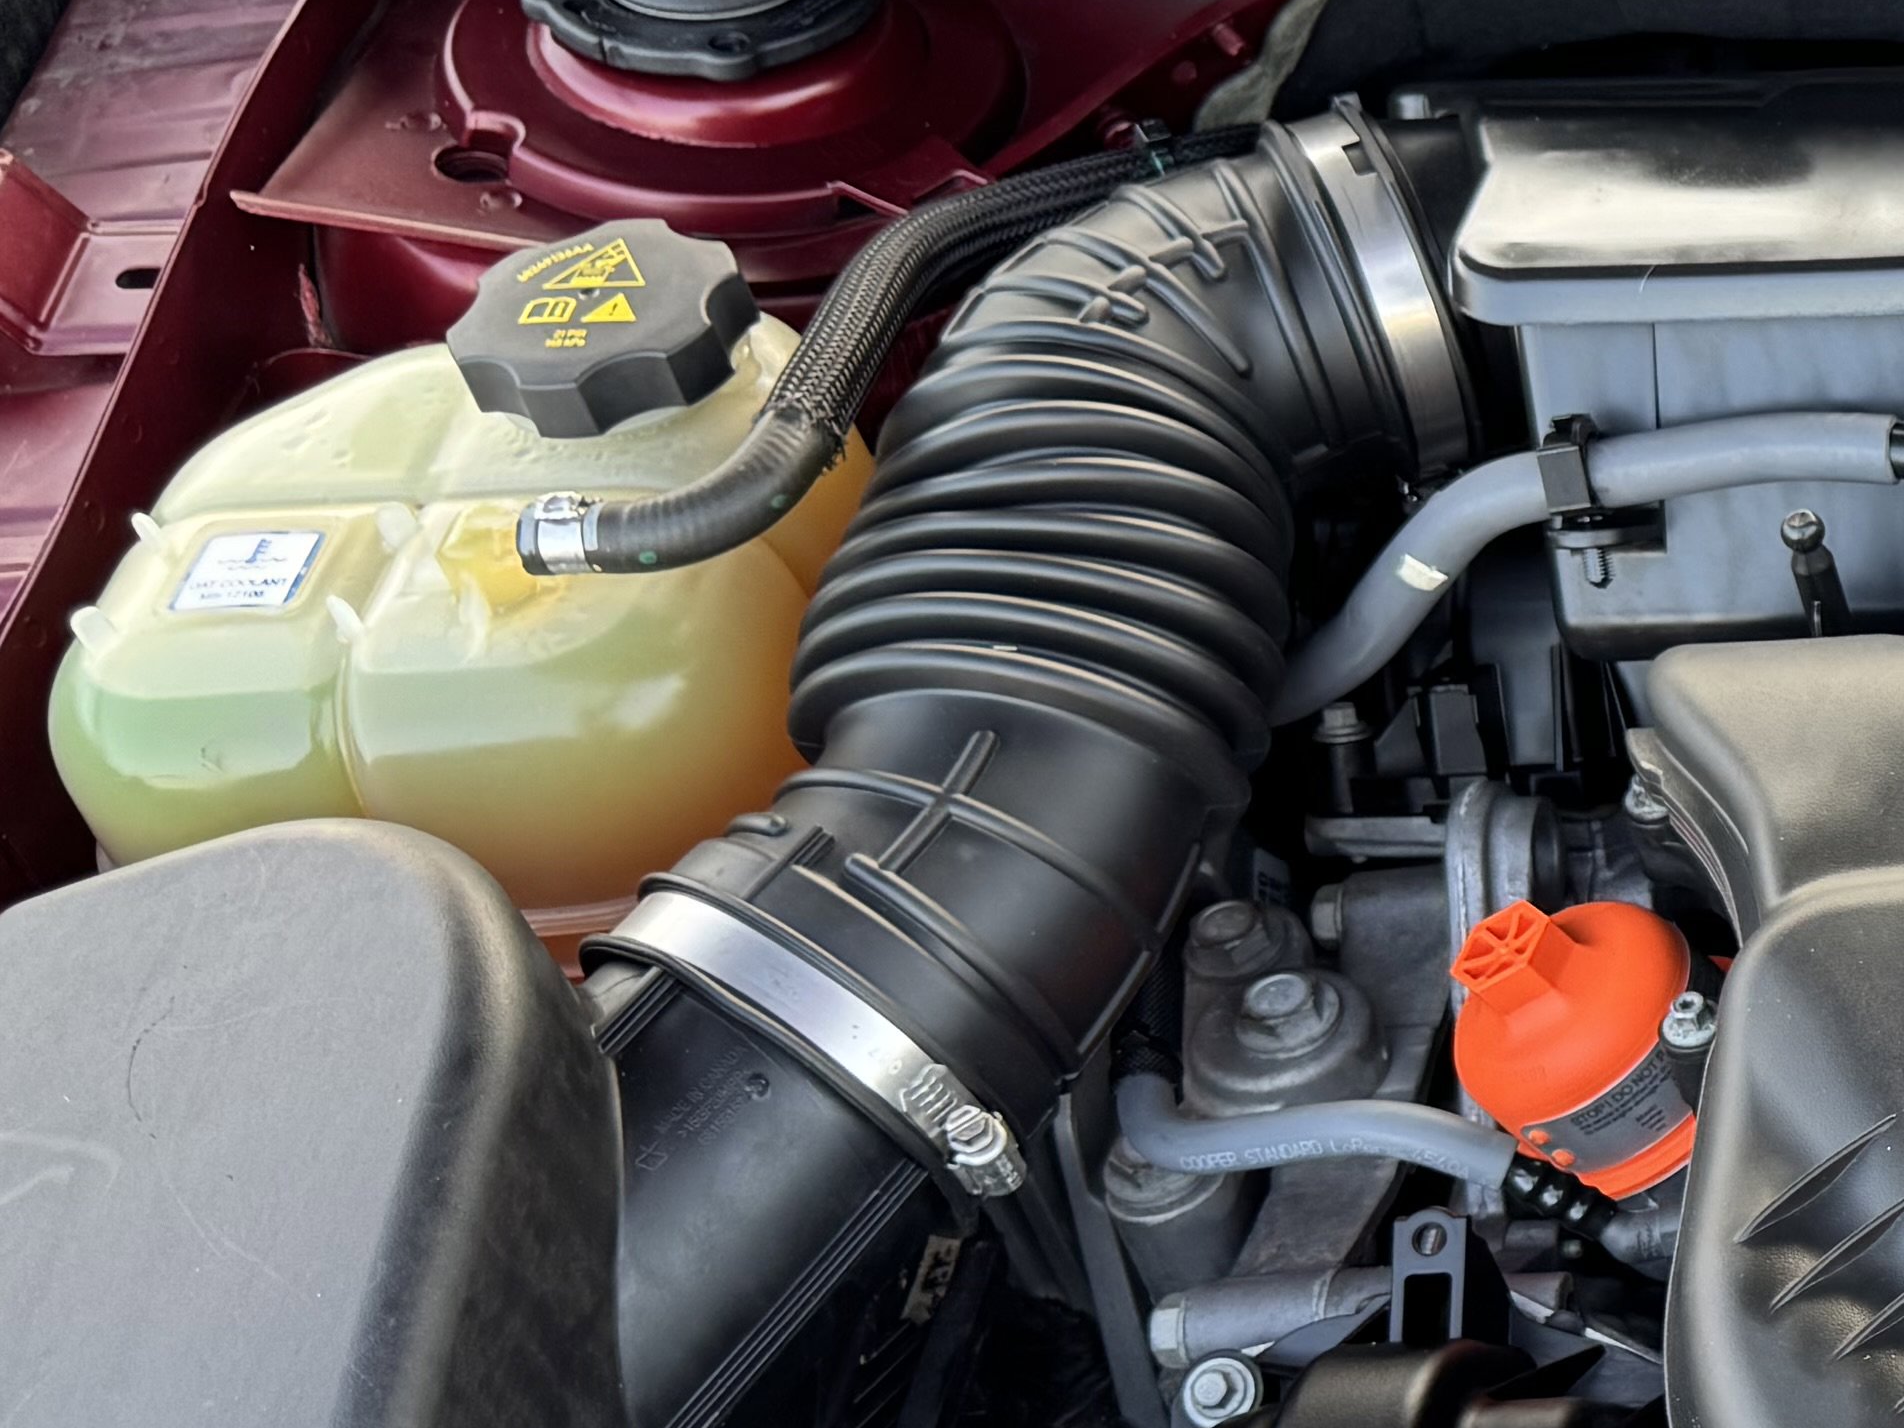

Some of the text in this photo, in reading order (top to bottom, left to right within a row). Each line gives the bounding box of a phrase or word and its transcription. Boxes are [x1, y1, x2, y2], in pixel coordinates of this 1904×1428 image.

[1612, 1085, 1631, 1101] DO
[1632, 1062, 1657, 1086] NOT
[1179, 1150, 1236, 1170] COOPER
[1244, 1140, 1322, 1166] STANDARD
